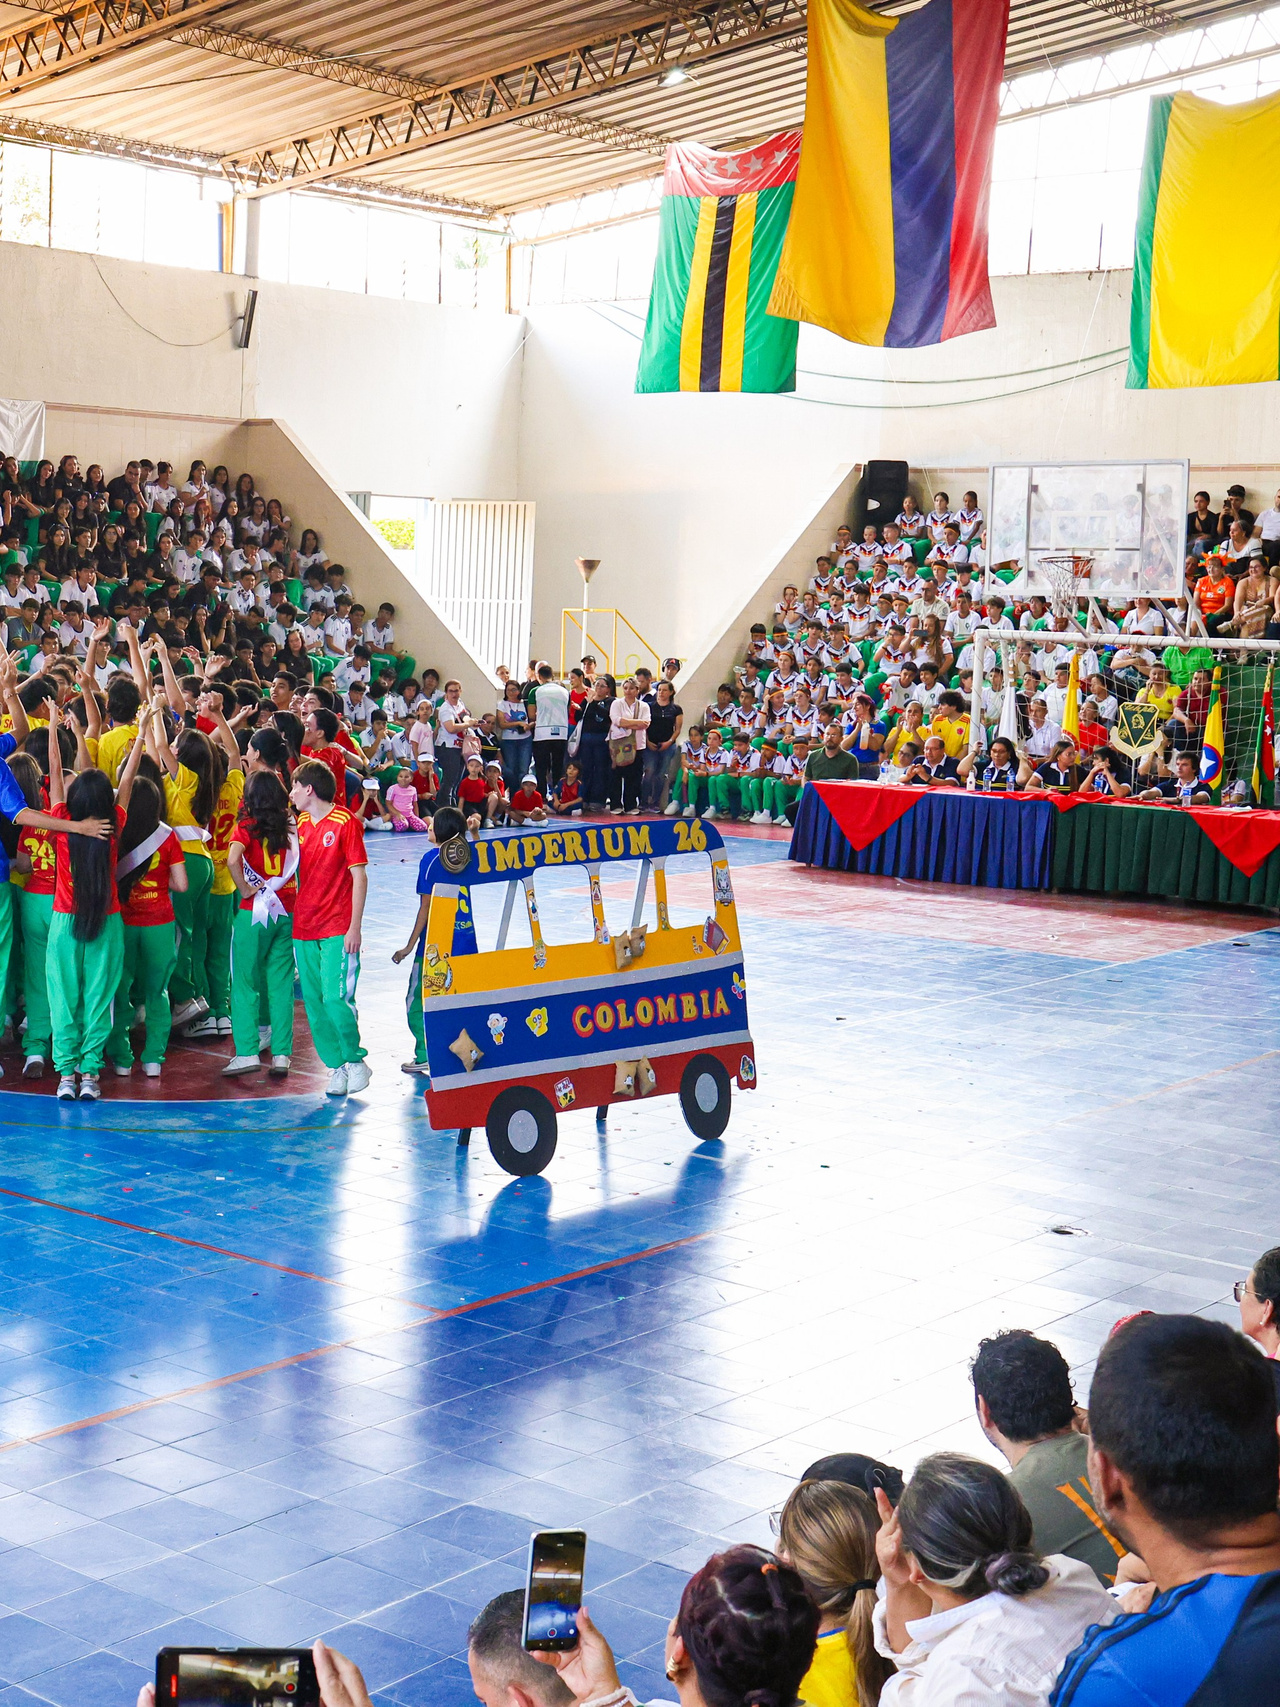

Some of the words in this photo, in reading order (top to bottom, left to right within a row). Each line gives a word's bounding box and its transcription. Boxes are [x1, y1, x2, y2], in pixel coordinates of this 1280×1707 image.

[475, 824, 653, 874] IMPERIUM
[673, 817, 708, 852] 26
[572, 987, 731, 1038] COLOMBIA
